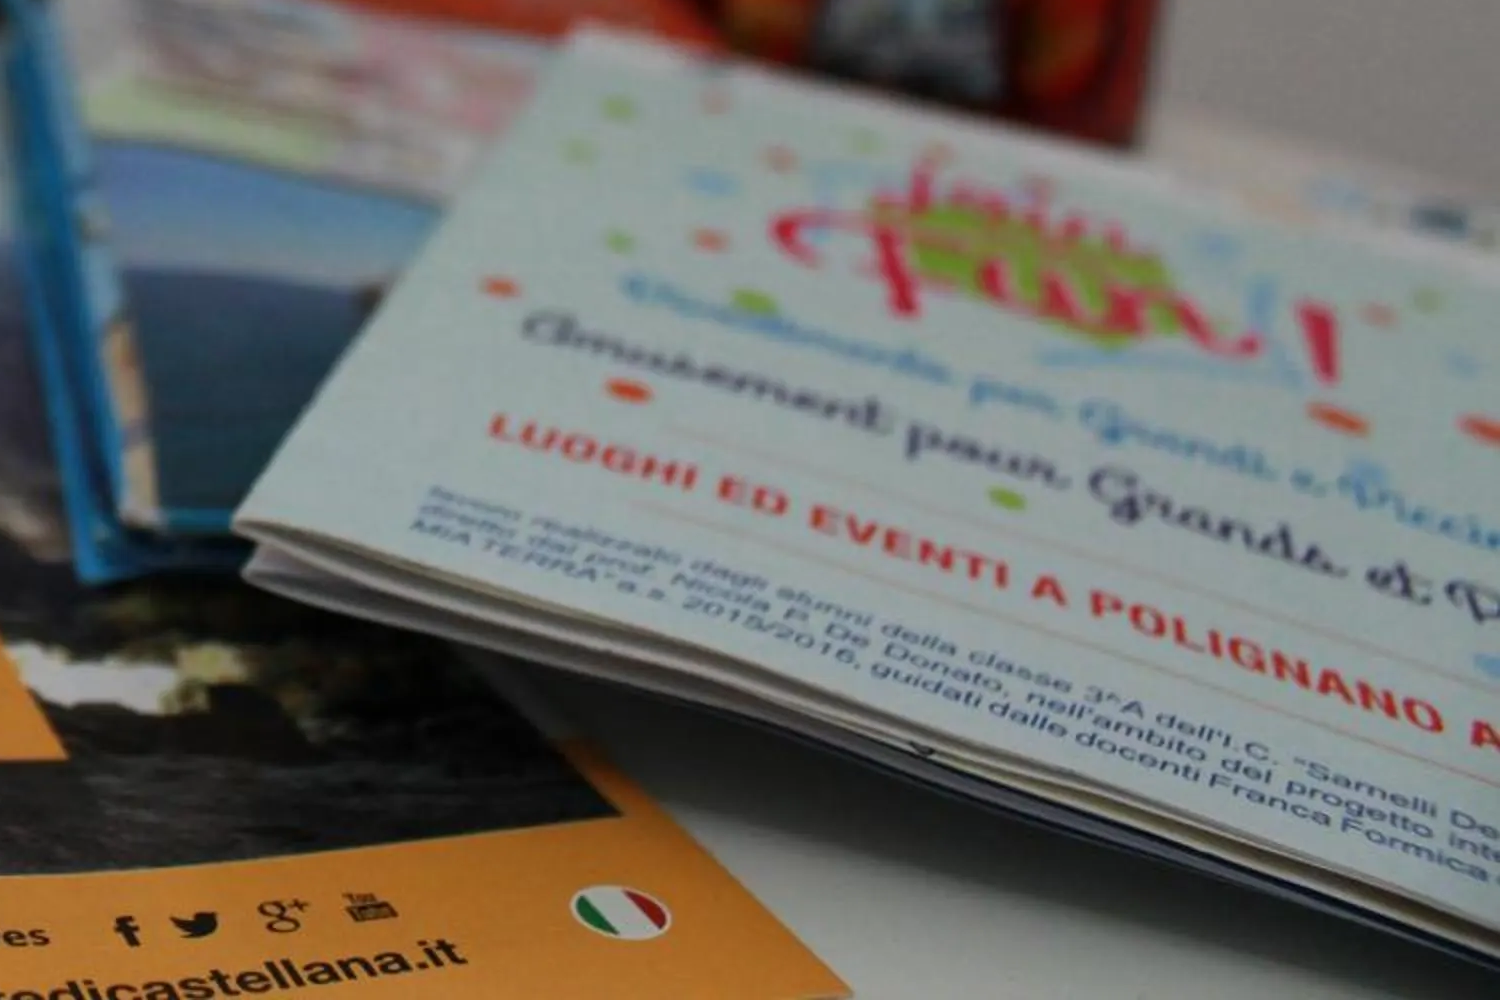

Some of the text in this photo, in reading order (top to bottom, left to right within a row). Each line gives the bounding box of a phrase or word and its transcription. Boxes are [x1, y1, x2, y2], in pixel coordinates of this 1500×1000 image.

[486, 412, 698, 490] LUOGHI
[716, 474, 791, 517] ED
[809, 503, 1010, 590] EVENTI
[1031, 574, 1069, 609] A
[1089, 588, 1445, 733] POLIGNANO
[880, 621, 959, 659] della
[967, 648, 1073, 695] classe
[669, 571, 772, 612] Nicola
[825, 621, 871, 649] De
[884, 642, 1010, 698] Donato,
[1026, 688, 1207, 763] nell'ambito
[1220, 755, 1273, 785] del
[1285, 779, 1434, 839] progetto
[870, 661, 982, 710] guidati
[988, 701, 1068, 738] dalle
[1075, 730, 1200, 784] docenti
[1208, 771, 1332, 827] Franca
[1340, 815, 1490, 883] Formica
